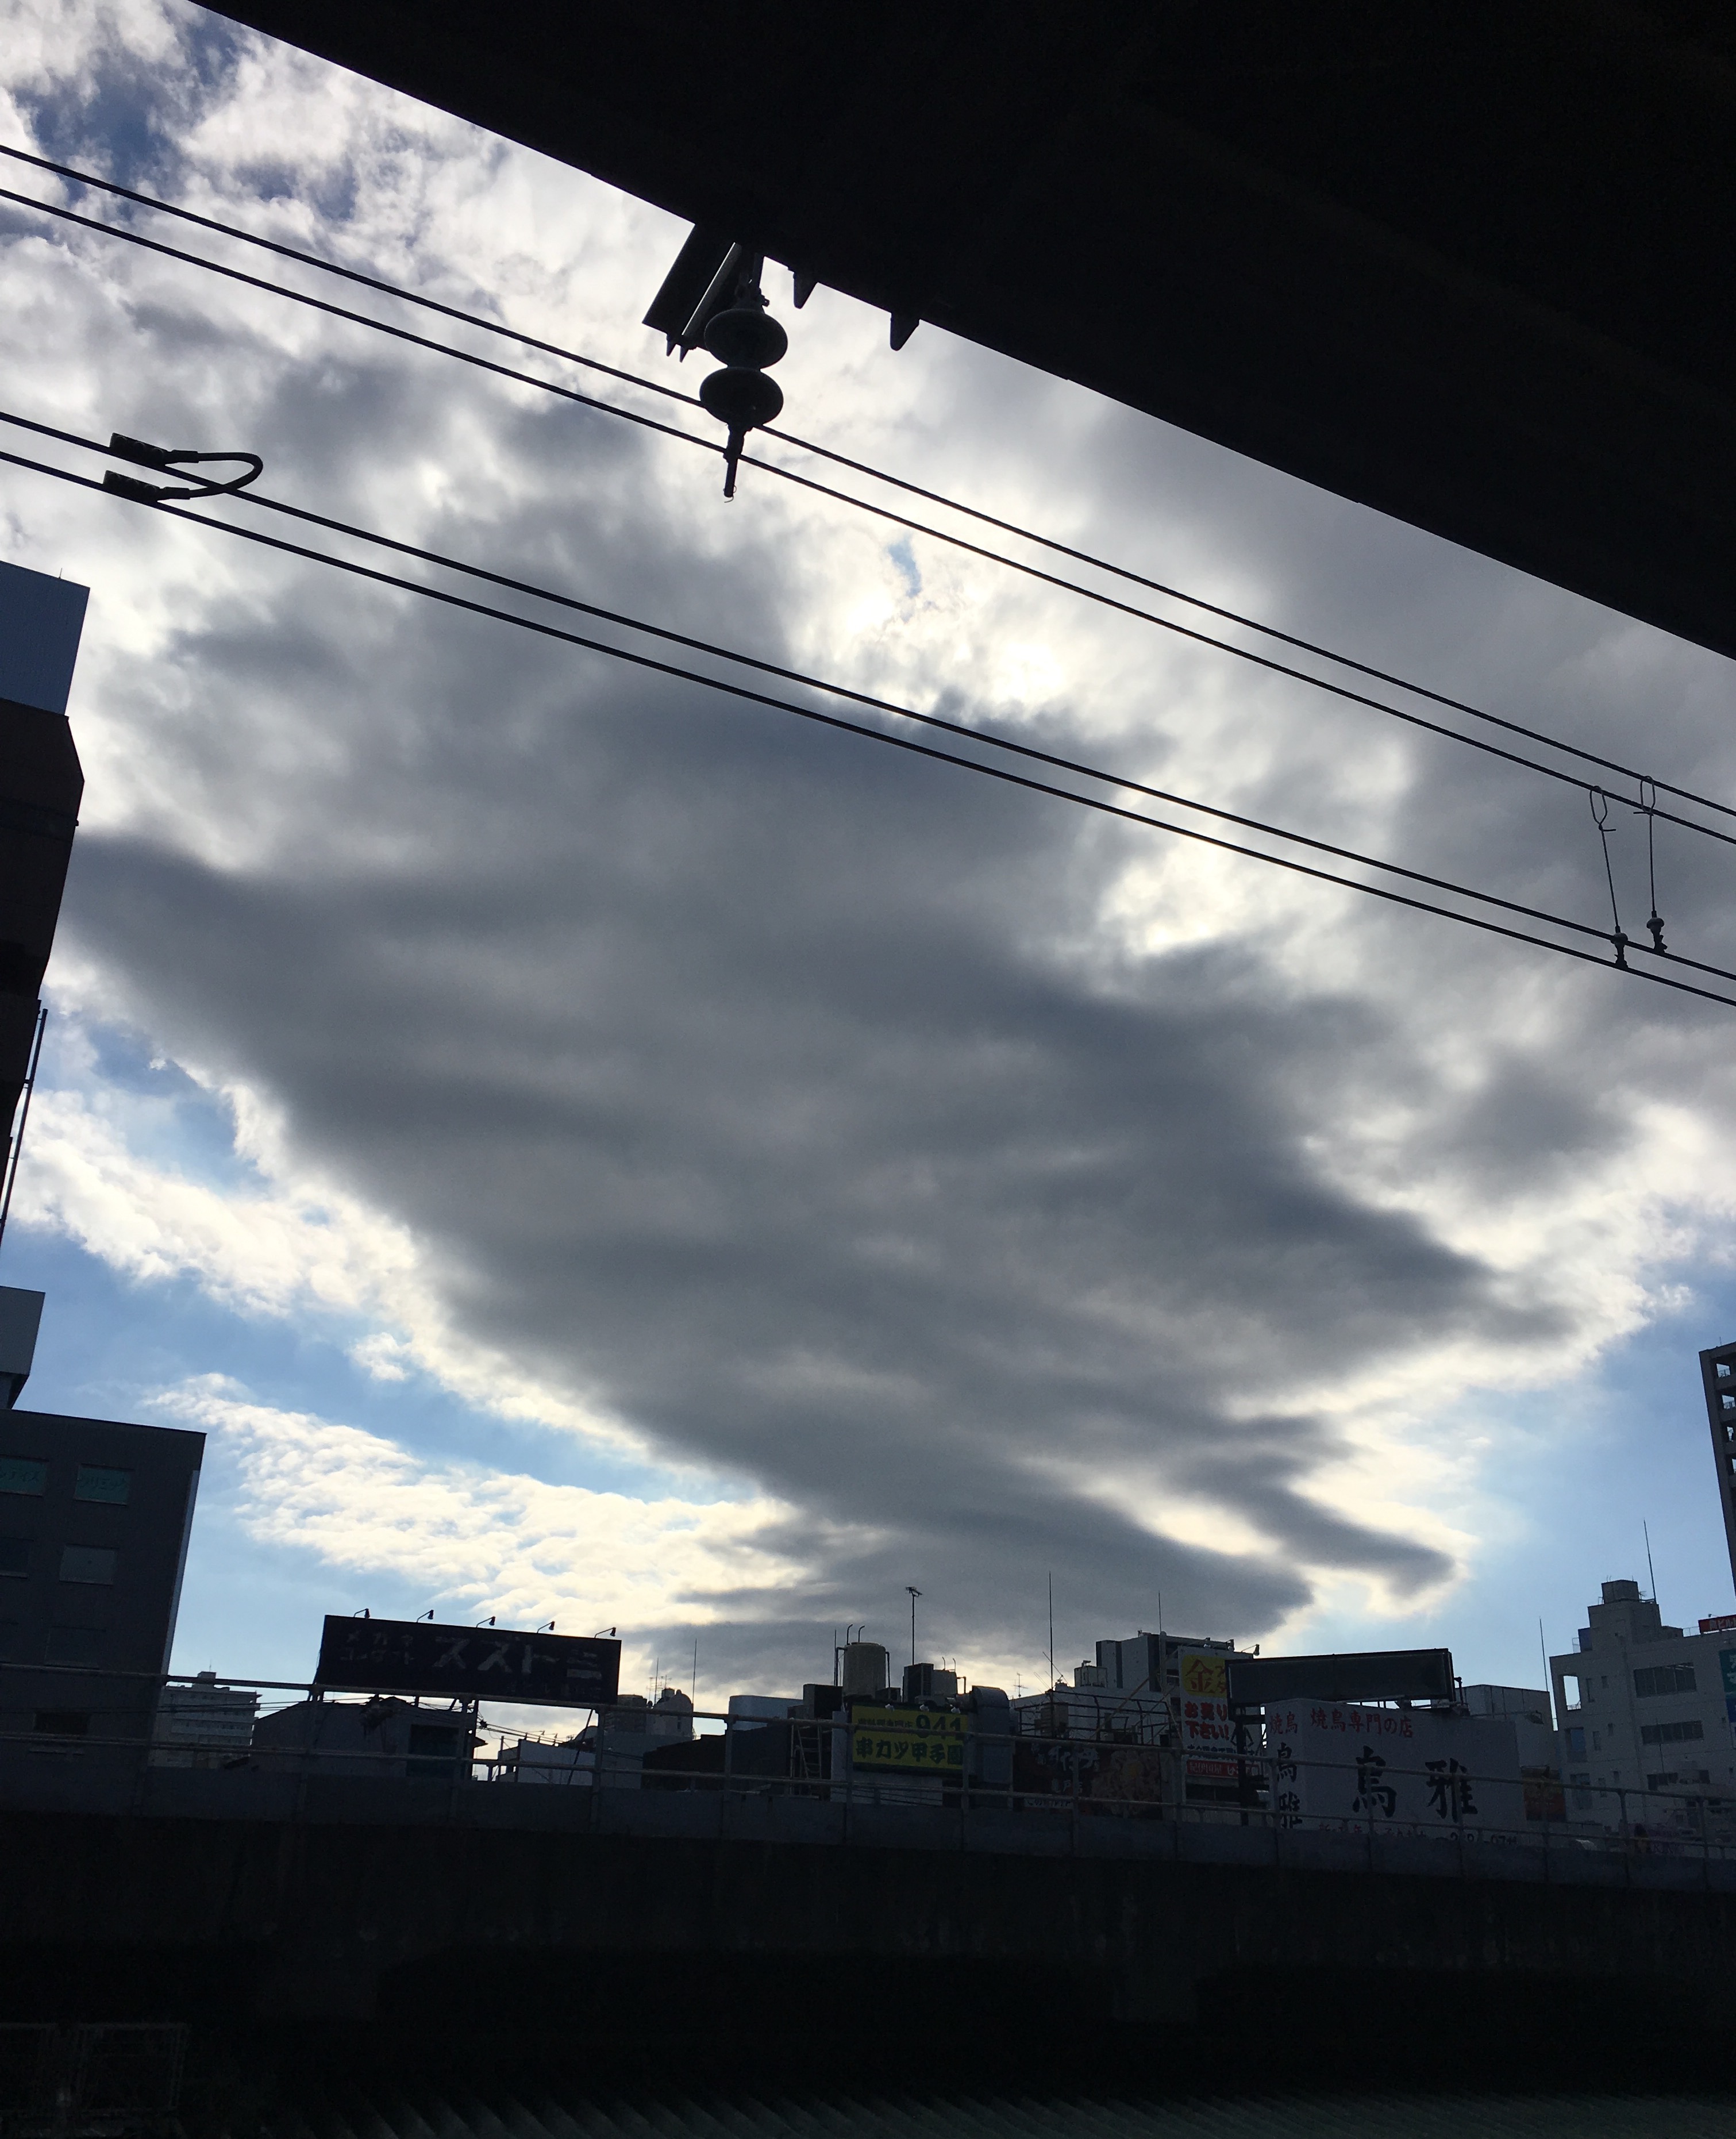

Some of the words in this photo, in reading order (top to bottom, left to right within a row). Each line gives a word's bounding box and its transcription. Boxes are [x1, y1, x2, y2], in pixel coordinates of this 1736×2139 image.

[916, 1714, 964, 1741] 941
[1269, 1711, 1298, 1735] 焼鳥
[1310, 1706, 1414, 1739] 焼鳥専門の店
[856, 1736, 963, 1765] 串カツ甲子園
